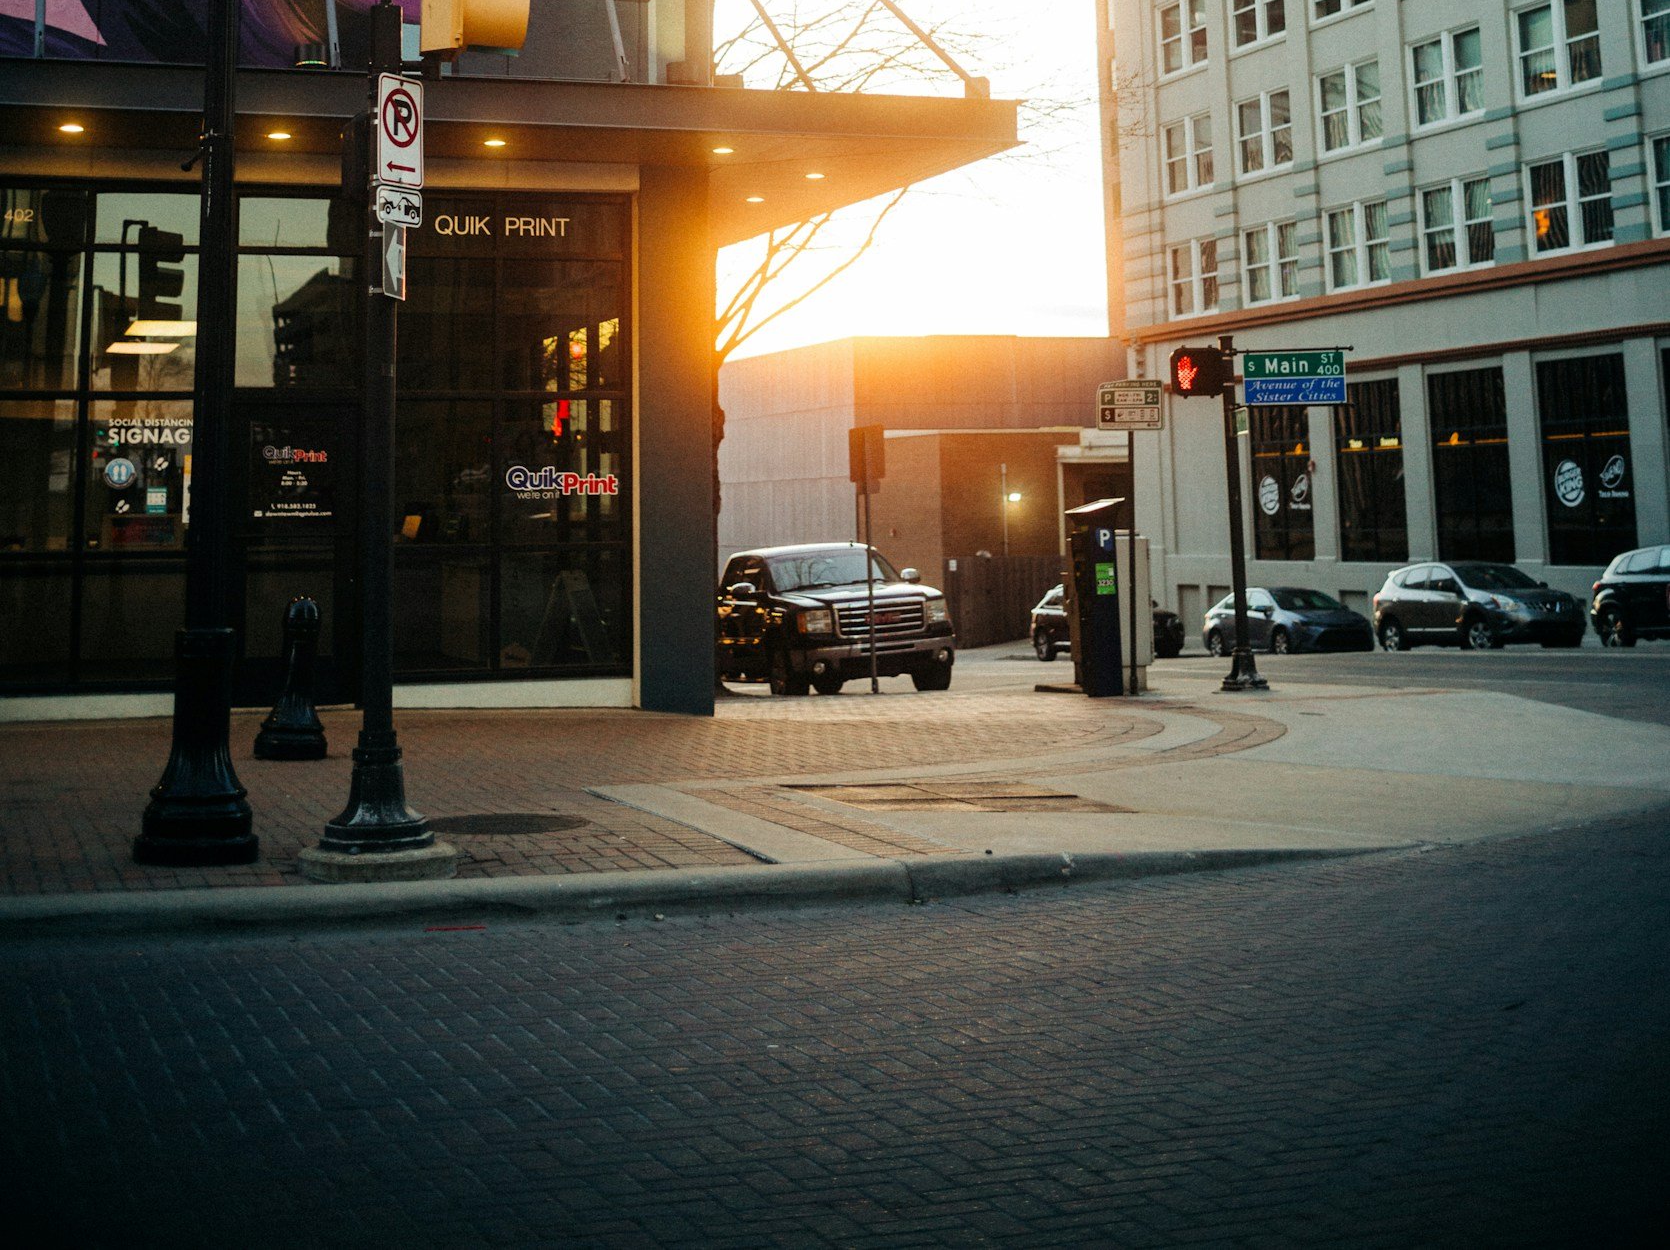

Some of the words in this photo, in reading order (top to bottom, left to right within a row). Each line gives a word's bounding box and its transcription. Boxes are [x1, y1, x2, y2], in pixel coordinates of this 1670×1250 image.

[4, 208, 34, 222] 402
[434, 215, 491, 236] QUIK
[505, 217, 570, 237] PRINT
[1248, 361, 1255, 371] S
[1265, 357, 1309, 374] Main
[1320, 353, 1334, 364] ST
[1316, 364, 1340, 375] 400
[1248, 381, 1298, 392] Avenue
[1302, 378, 1319, 391] of
[1320, 378, 1341, 389] the
[1105, 394, 1111, 403] P
[1253, 391, 1294, 403] Sister
[1298, 390, 1338, 401] Cities
[108, 418, 143, 427] SOCIAL
[144, 418, 194, 427] DISTANCIN
[107, 428, 194, 445] SIGNAG
[516, 491, 540, 500] we're
[1099, 529, 1111, 547] P
